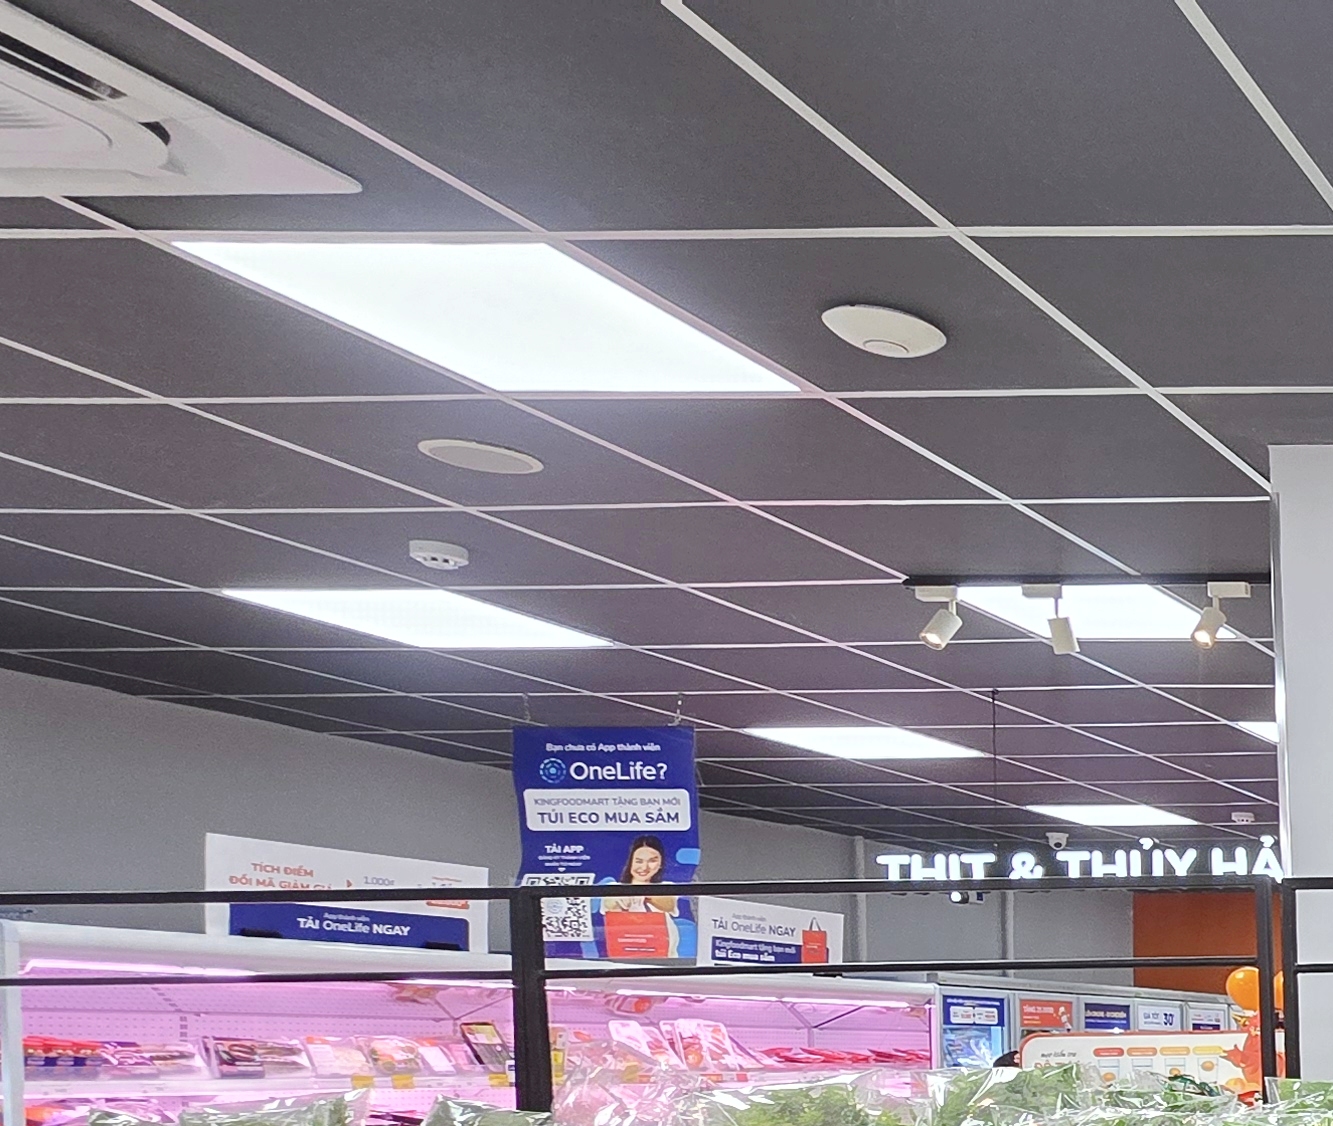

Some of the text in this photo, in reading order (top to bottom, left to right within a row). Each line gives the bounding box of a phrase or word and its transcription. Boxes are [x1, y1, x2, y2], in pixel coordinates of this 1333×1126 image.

[570, 761, 668, 781] OneLife?
[537, 808, 564, 825] TÚI
[568, 812, 600, 824] ECO
[604, 812, 641, 824] MUA
[545, 843, 561, 854] TẢI
[1009, 852, 1043, 880] &
[1055, 836, 1197, 878] THỦY
[251, 862, 281, 875] TÍCH
[297, 915, 320, 929] TẢI
[322, 919, 370, 934] OneLife
[372, 923, 410, 936] NGAY
[712, 917, 728, 930] TẢI
[731, 921, 767, 934] OneLife
[768, 925, 797, 937] NGAY
